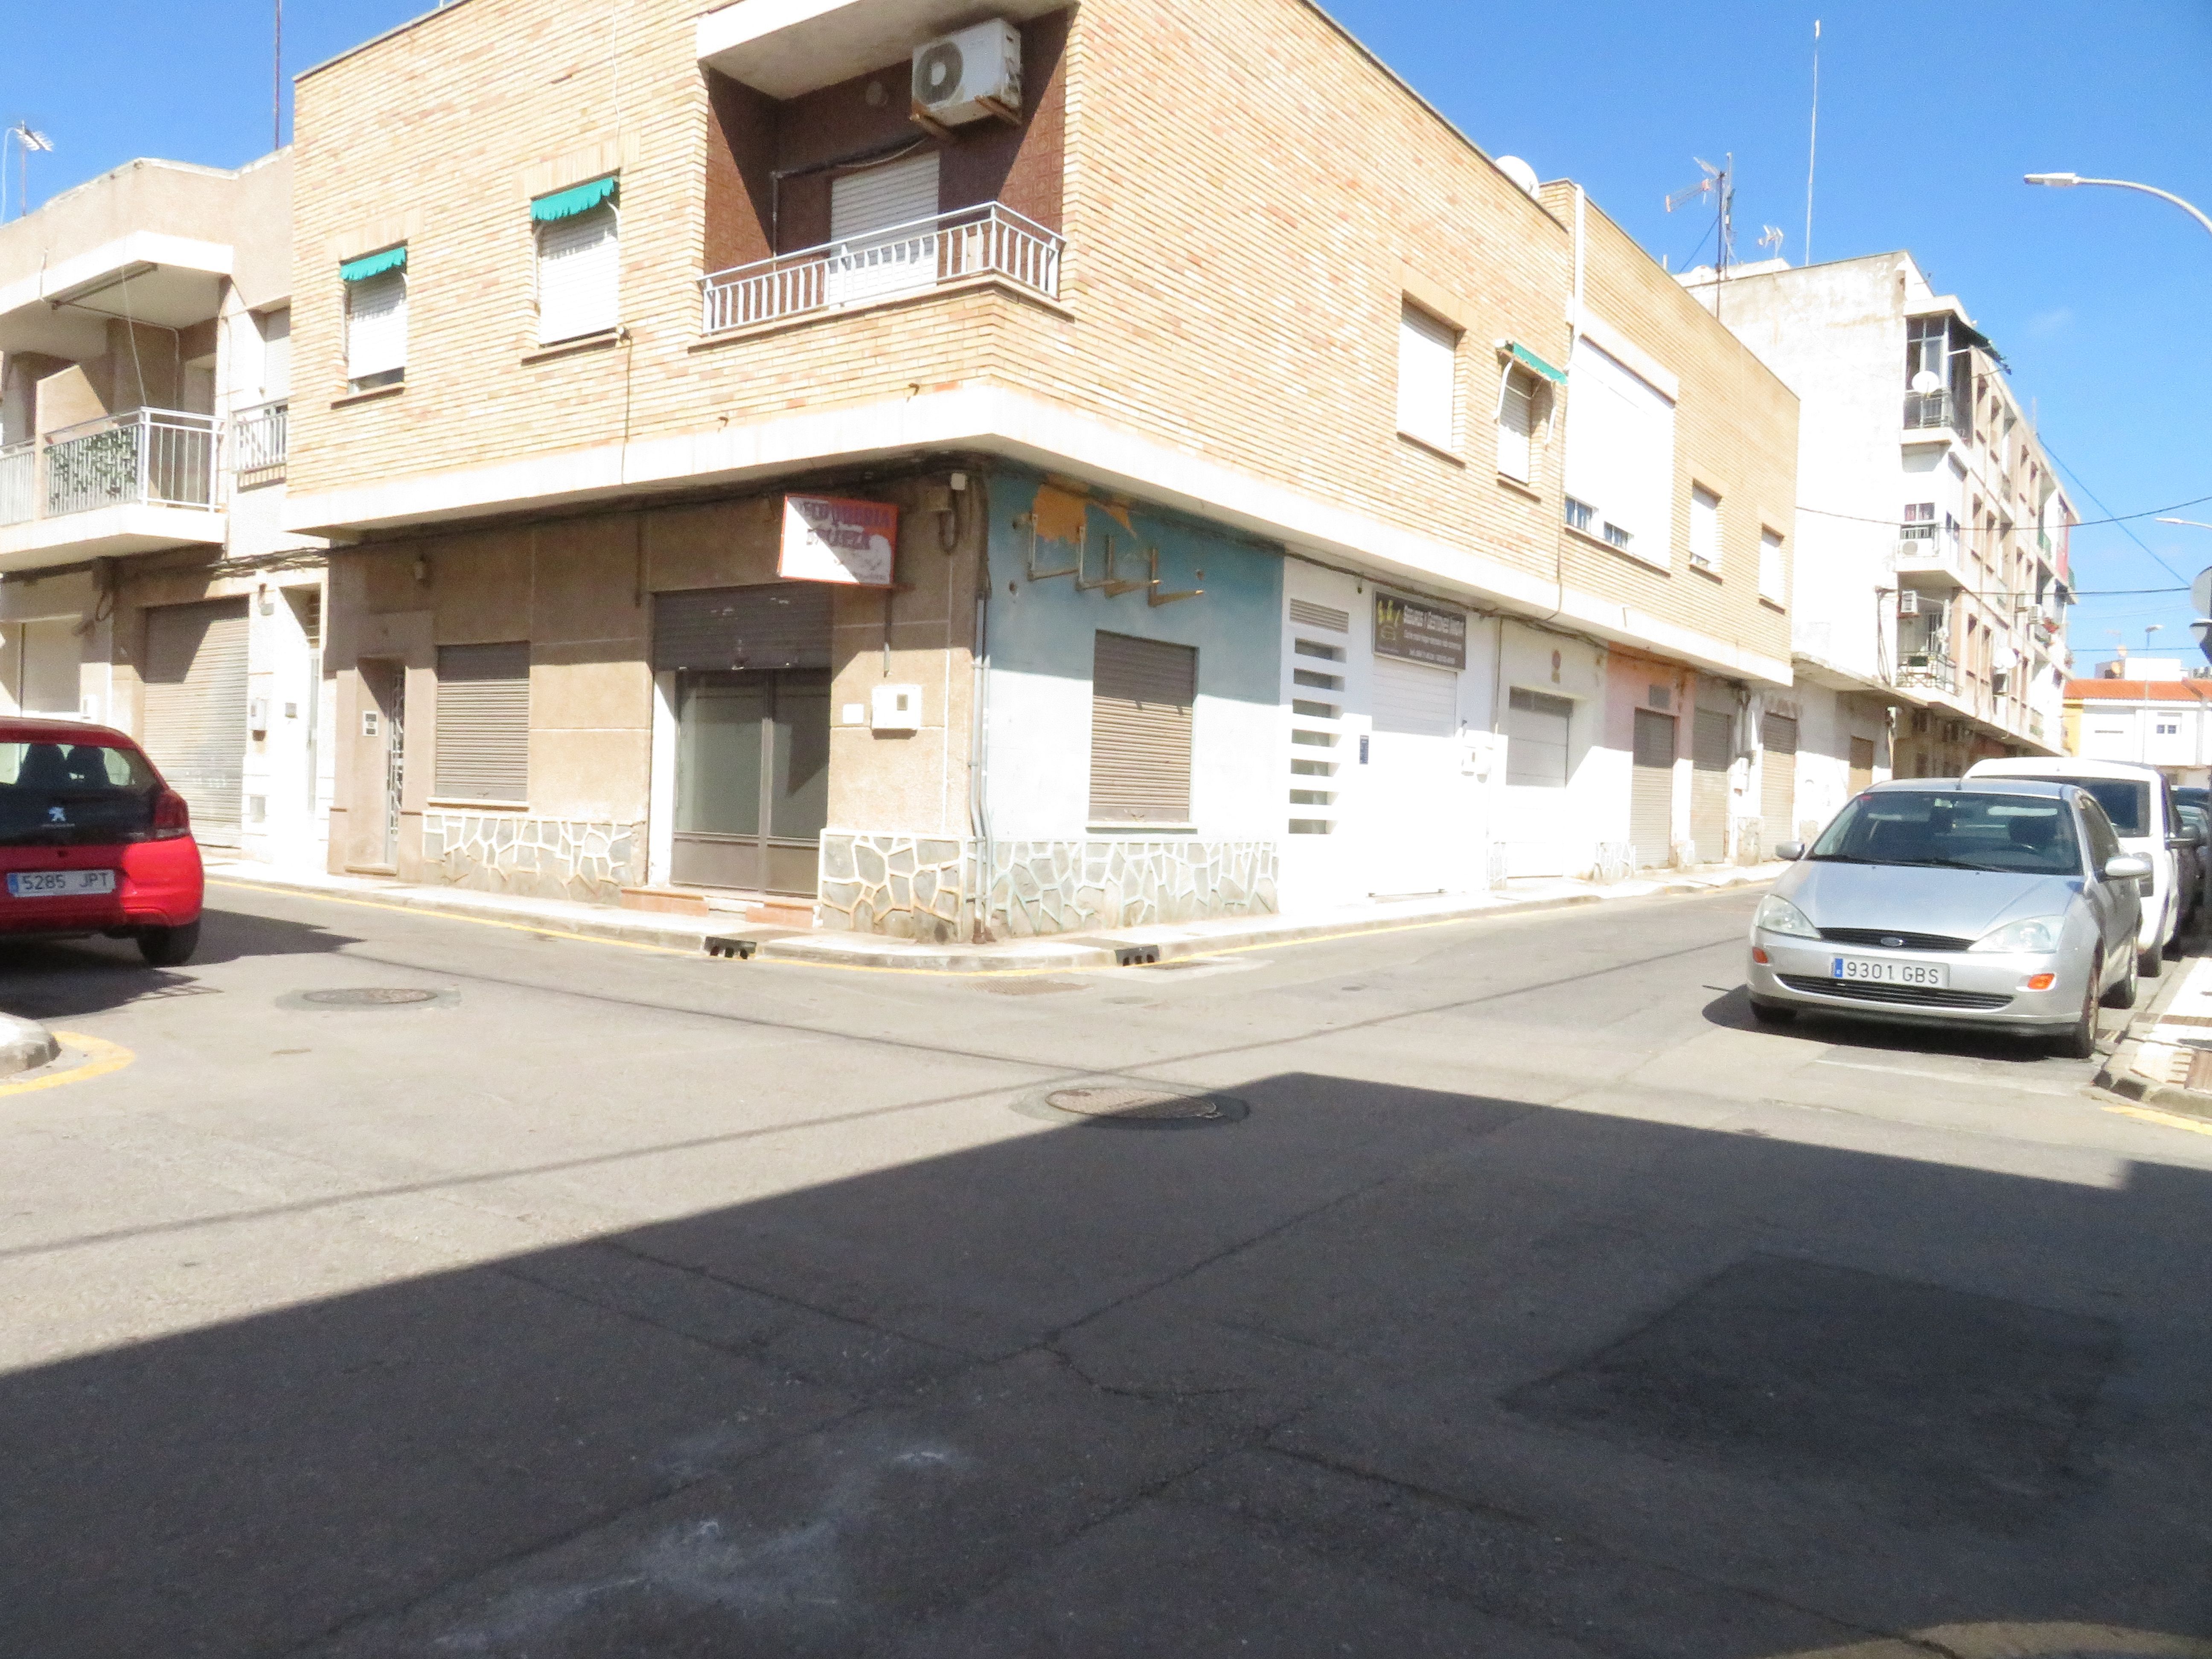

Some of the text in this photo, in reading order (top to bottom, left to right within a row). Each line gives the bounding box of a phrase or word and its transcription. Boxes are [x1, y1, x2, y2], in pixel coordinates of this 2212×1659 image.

[22, 872, 109, 890] 5285 JPT
[1847, 961, 1938, 984] 9301 GBS
